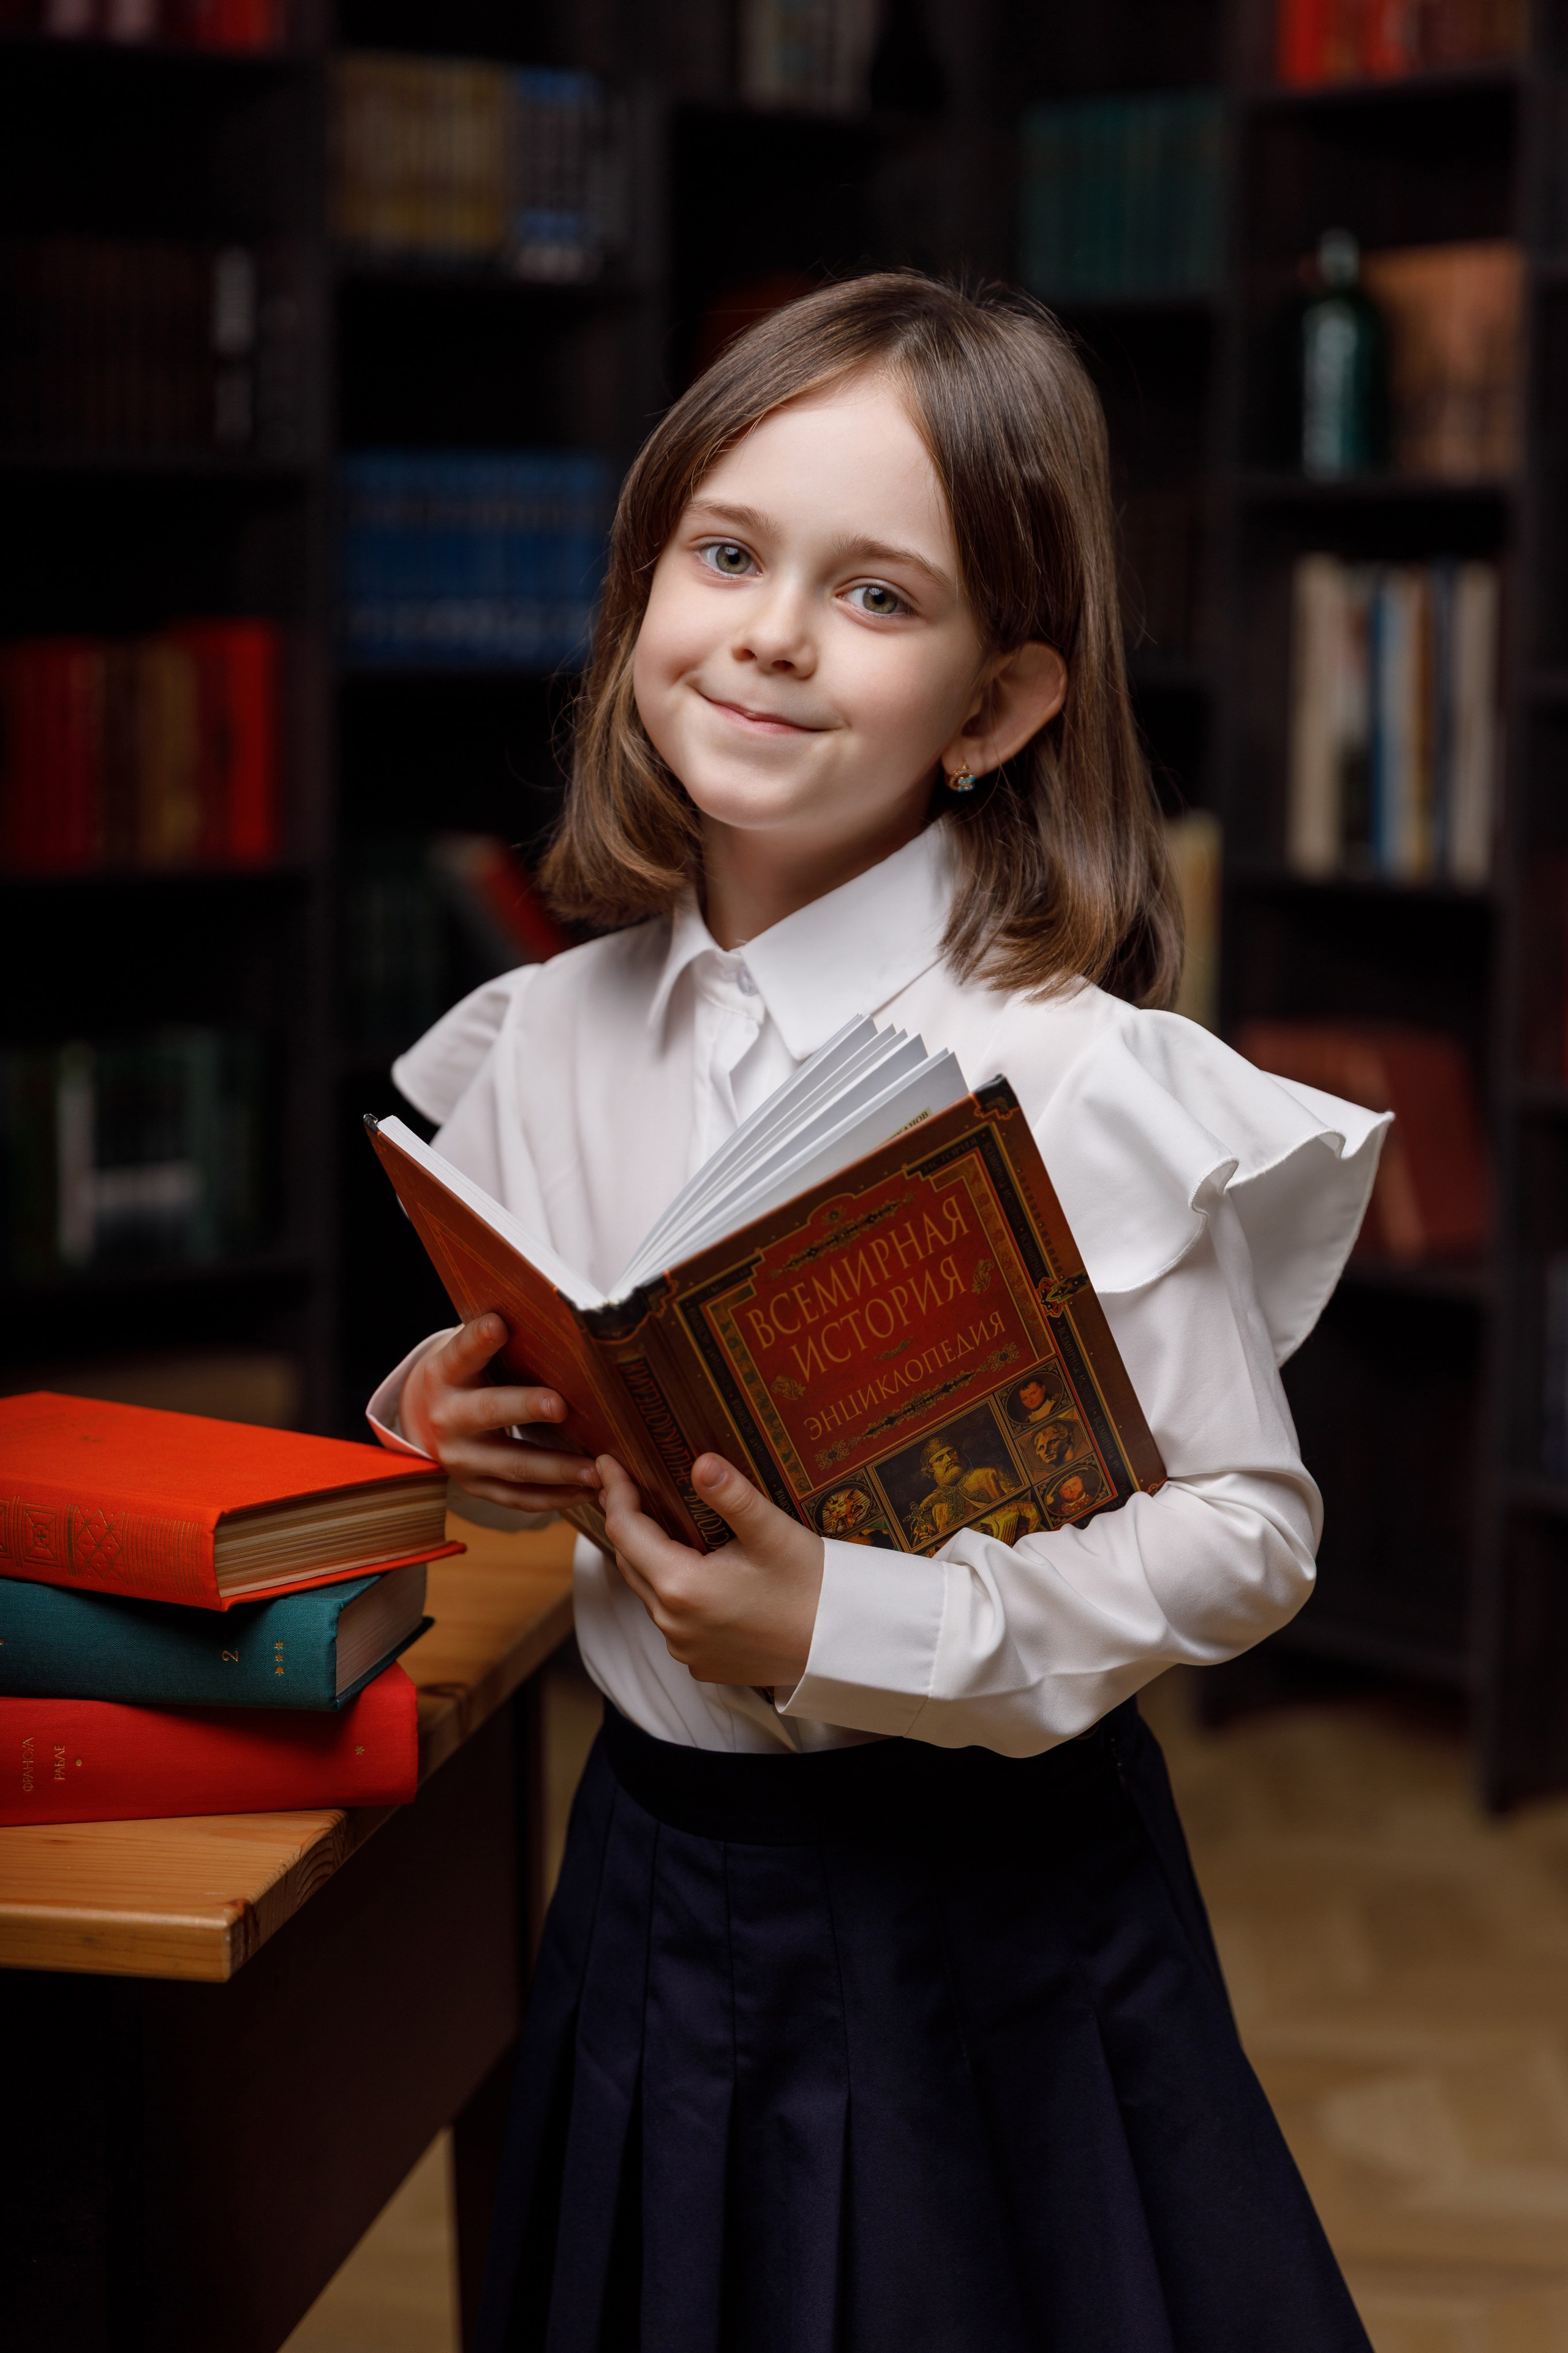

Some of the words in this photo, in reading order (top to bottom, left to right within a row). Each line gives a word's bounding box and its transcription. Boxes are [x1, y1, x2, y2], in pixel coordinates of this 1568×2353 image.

[746, 1195, 970, 1349] ВСЕМИРНАЯ
[1019, 1232, 1044, 1278] ВСЕМИРНАЯ
[790, 1255, 967, 1382] ИСТОРИЯ
[804, 1310, 1006, 1440] ЭНЦИКЛОПЕДИЯ
[1057, 1326, 1082, 1373] ВСЕМИРНАЯ
[1076, 1375, 1097, 1411] ИСТОРИЯ
[1093, 1416, 1117, 1459] ВСЕМИРНАЯ
[684, 1495, 729, 1549] СТОРИЯ
[222, 1649, 239, 1662] 2
[54, 1745, 65, 1780] РАБЛЕ
